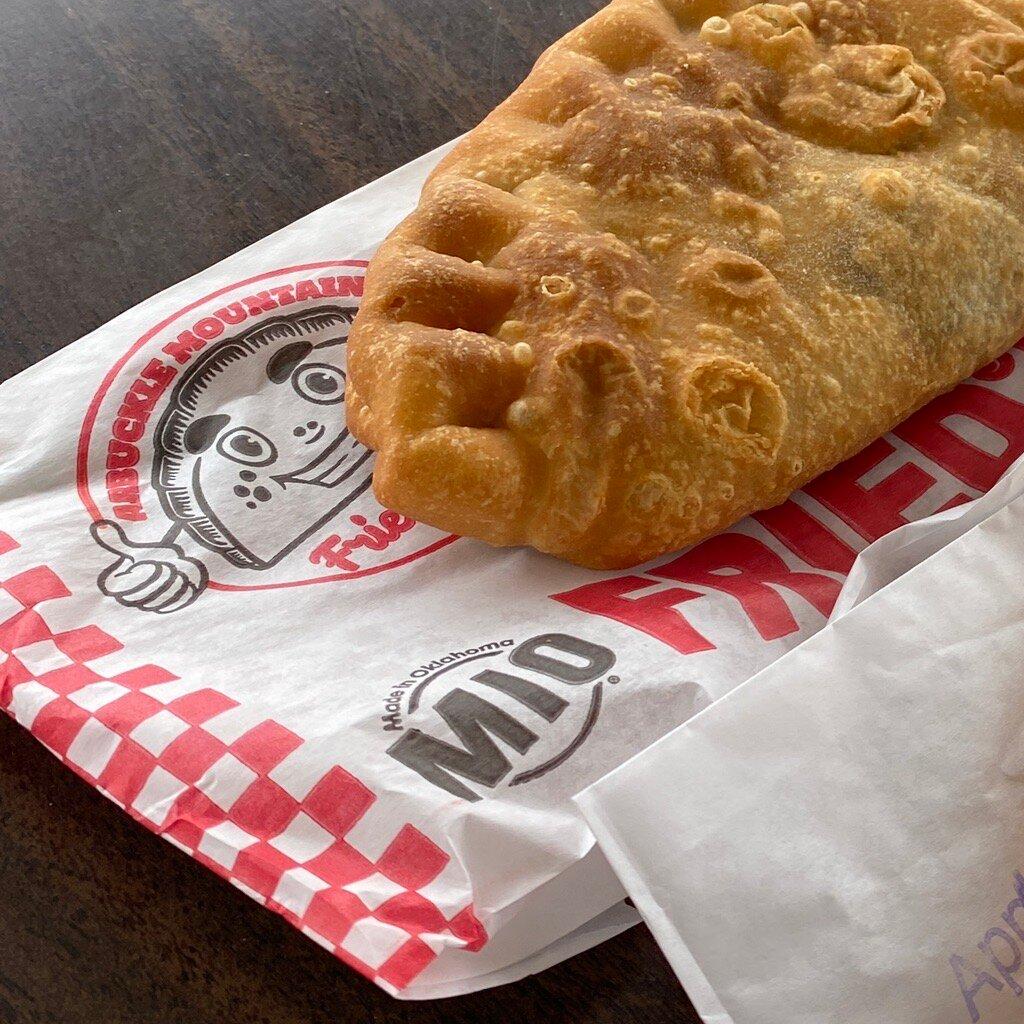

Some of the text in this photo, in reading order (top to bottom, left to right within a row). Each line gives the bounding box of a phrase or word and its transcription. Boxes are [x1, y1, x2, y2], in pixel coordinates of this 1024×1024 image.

[382, 689, 404, 732] Made
[409, 638, 515, 679] Oklahoma
[385, 632, 617, 804] MIO
